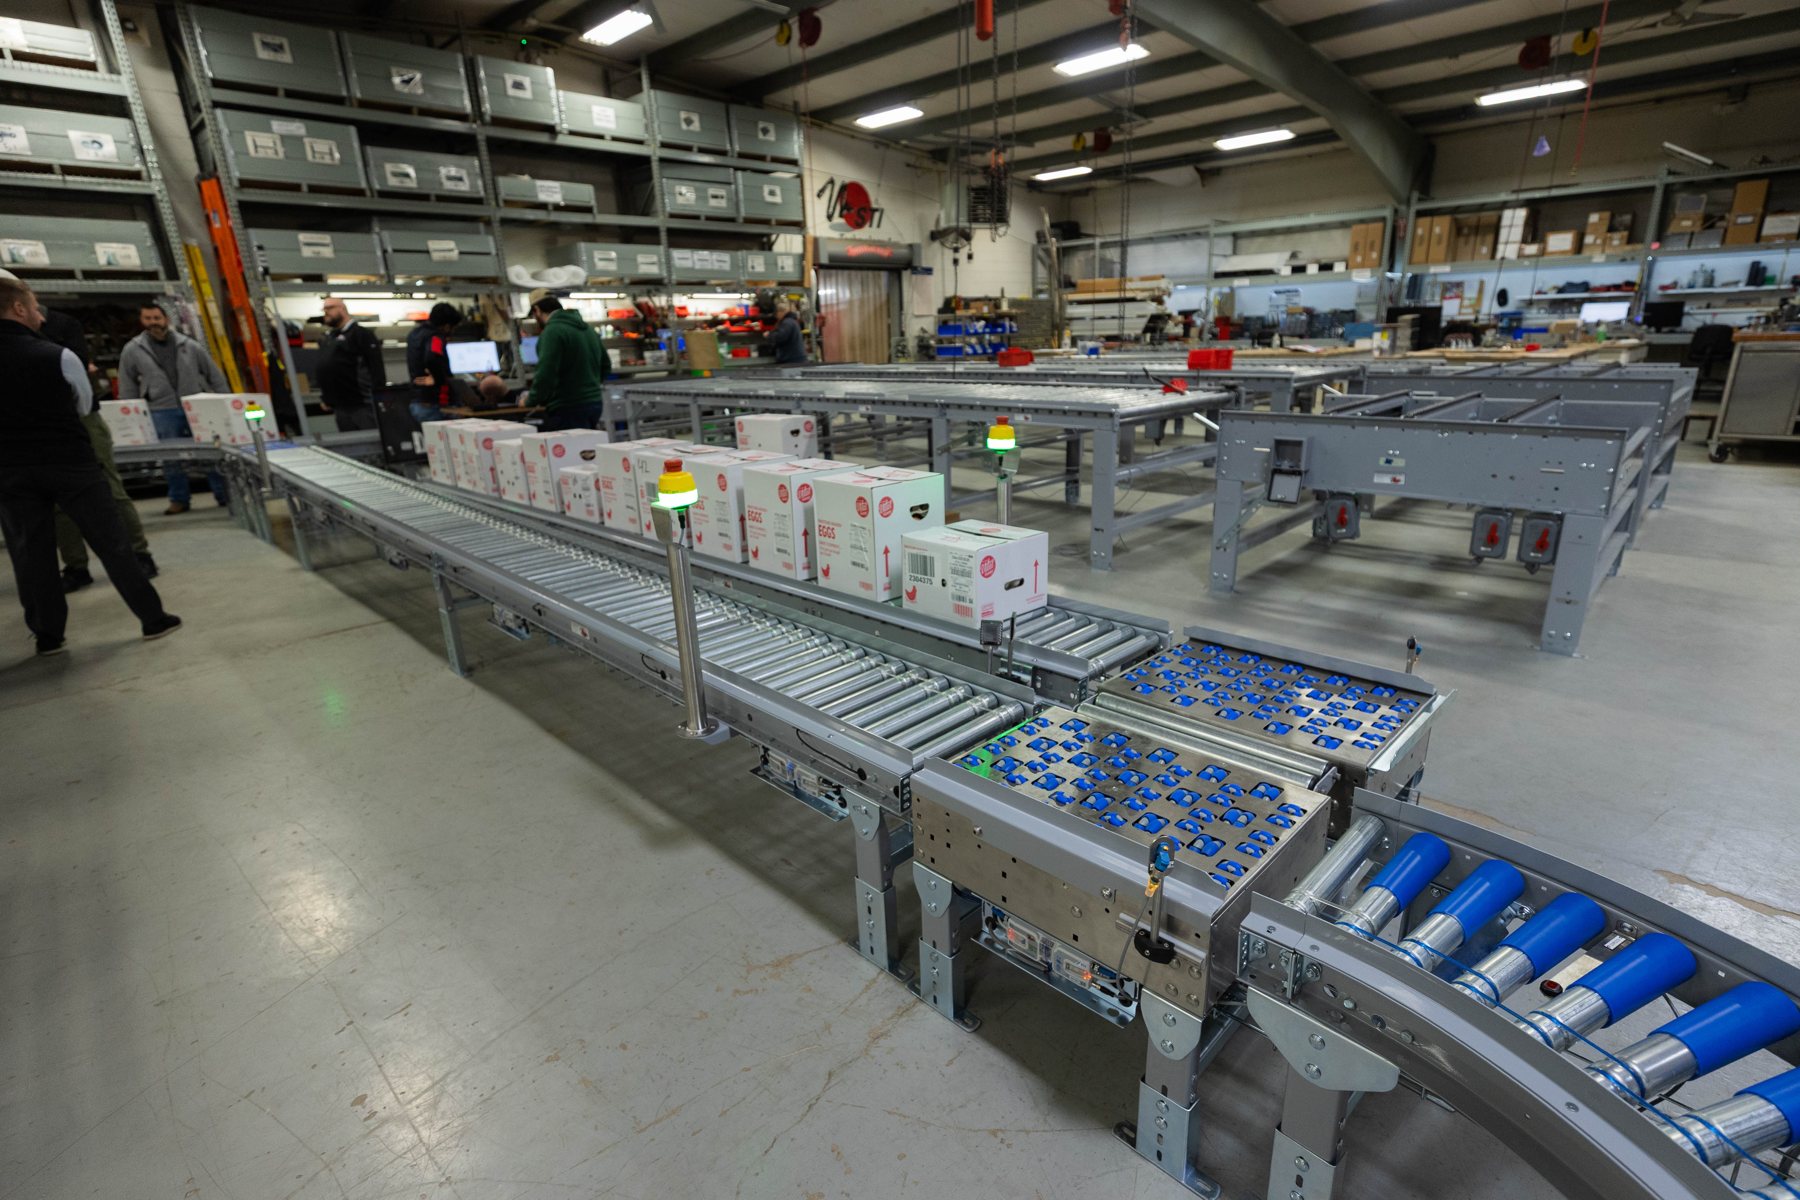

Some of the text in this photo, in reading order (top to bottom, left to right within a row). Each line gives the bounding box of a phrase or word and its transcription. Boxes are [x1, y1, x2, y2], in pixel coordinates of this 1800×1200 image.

[747, 510, 763, 523] EGGS
[818, 525, 836, 539] EGGS
[908, 574, 933, 585] 2304375
